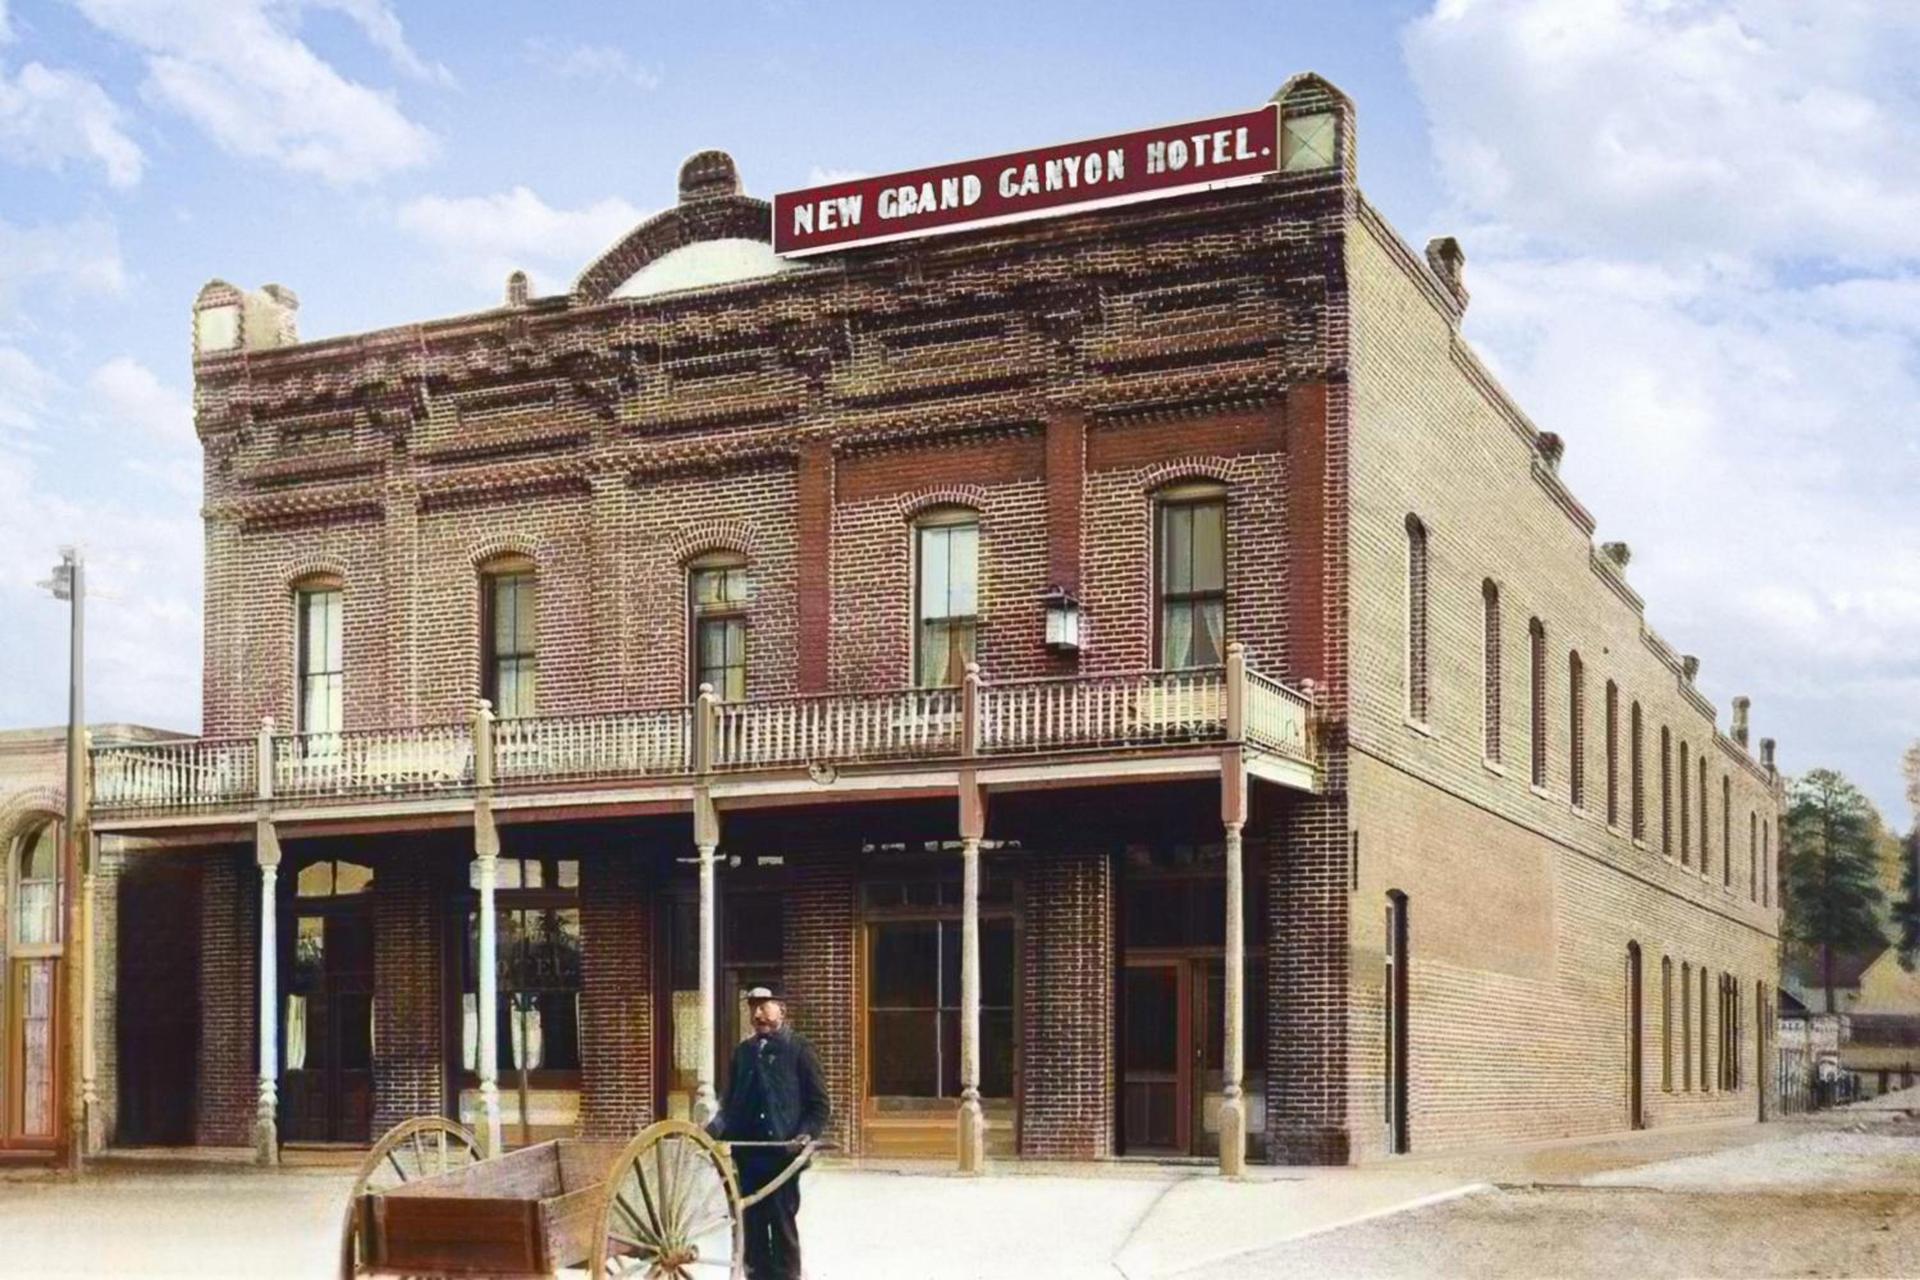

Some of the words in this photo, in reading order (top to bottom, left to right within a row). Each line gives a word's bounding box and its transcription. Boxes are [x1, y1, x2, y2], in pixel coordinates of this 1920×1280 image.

[793, 194, 862, 235] NEW
[877, 174, 982, 220] GRAND
[998, 148, 1125, 198] CANYON
[1146, 126, 1270, 174] HOTEL.
